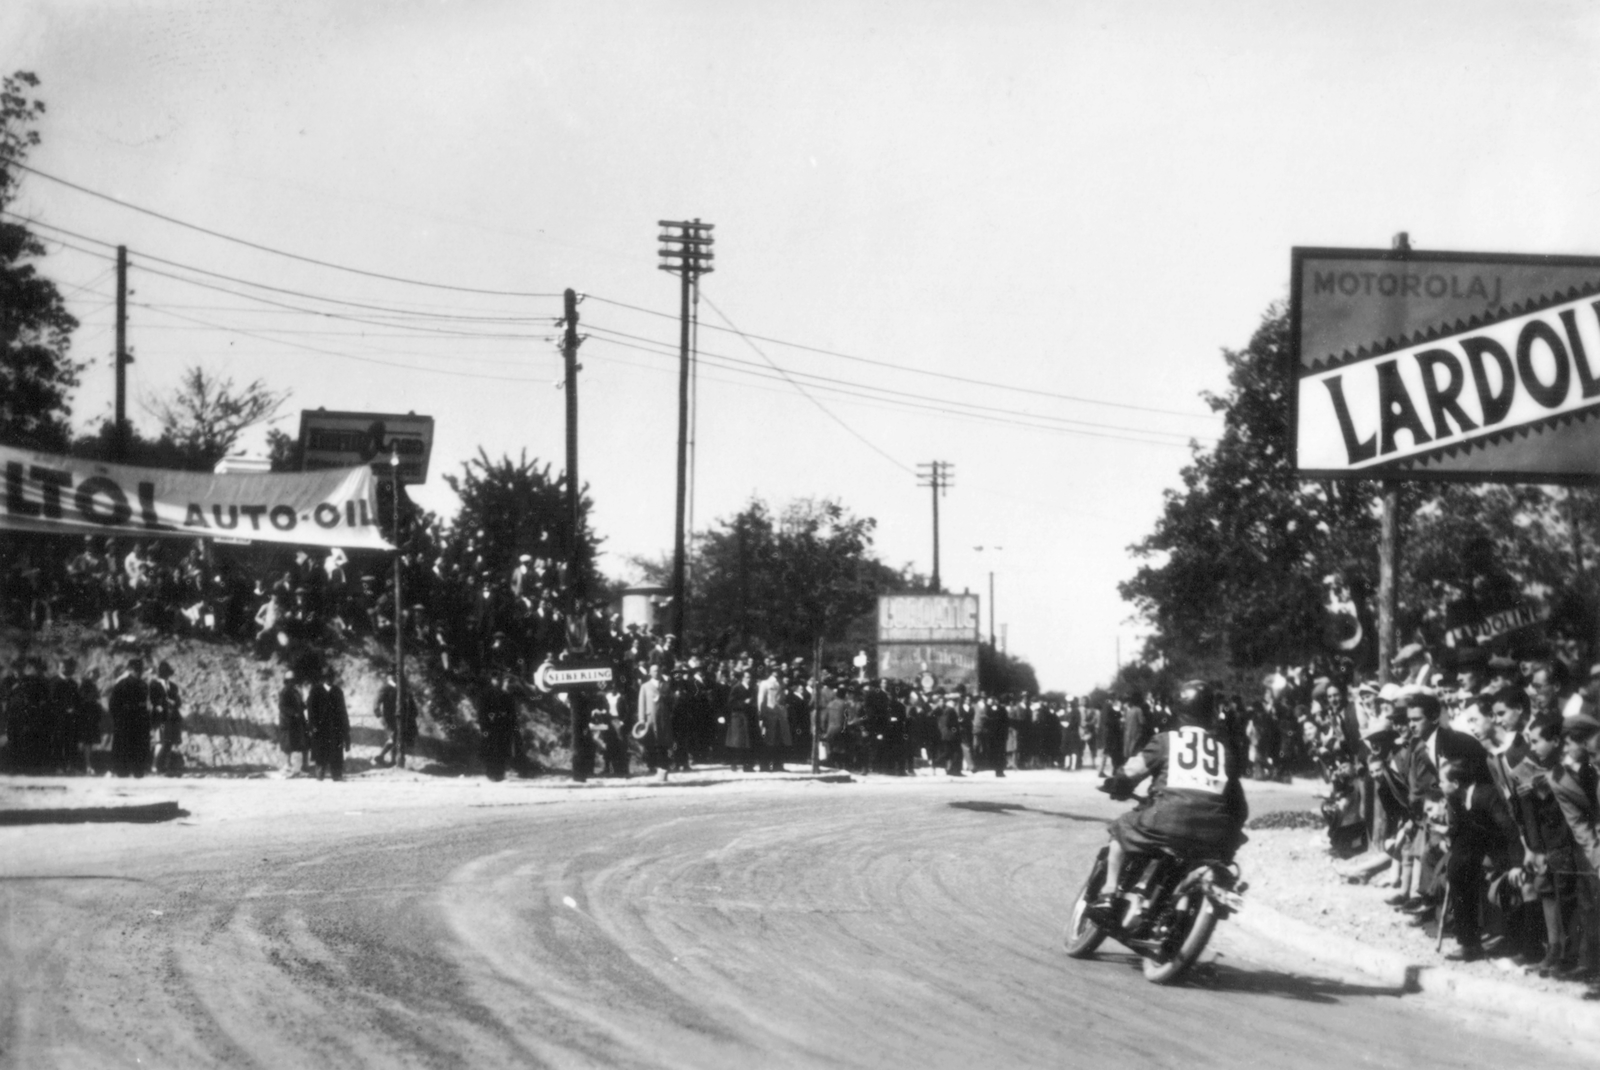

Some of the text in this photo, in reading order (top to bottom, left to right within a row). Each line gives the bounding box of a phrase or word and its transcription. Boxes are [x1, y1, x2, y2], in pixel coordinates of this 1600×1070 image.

[1313, 270, 1502, 308] MOTOROLAJ
[1321, 299, 1600, 466] LARDOL
[183, 498, 379, 531] AUTO-OIL
[548, 671, 611, 681] SEIBERLING
[1177, 731, 1219, 777] 39
